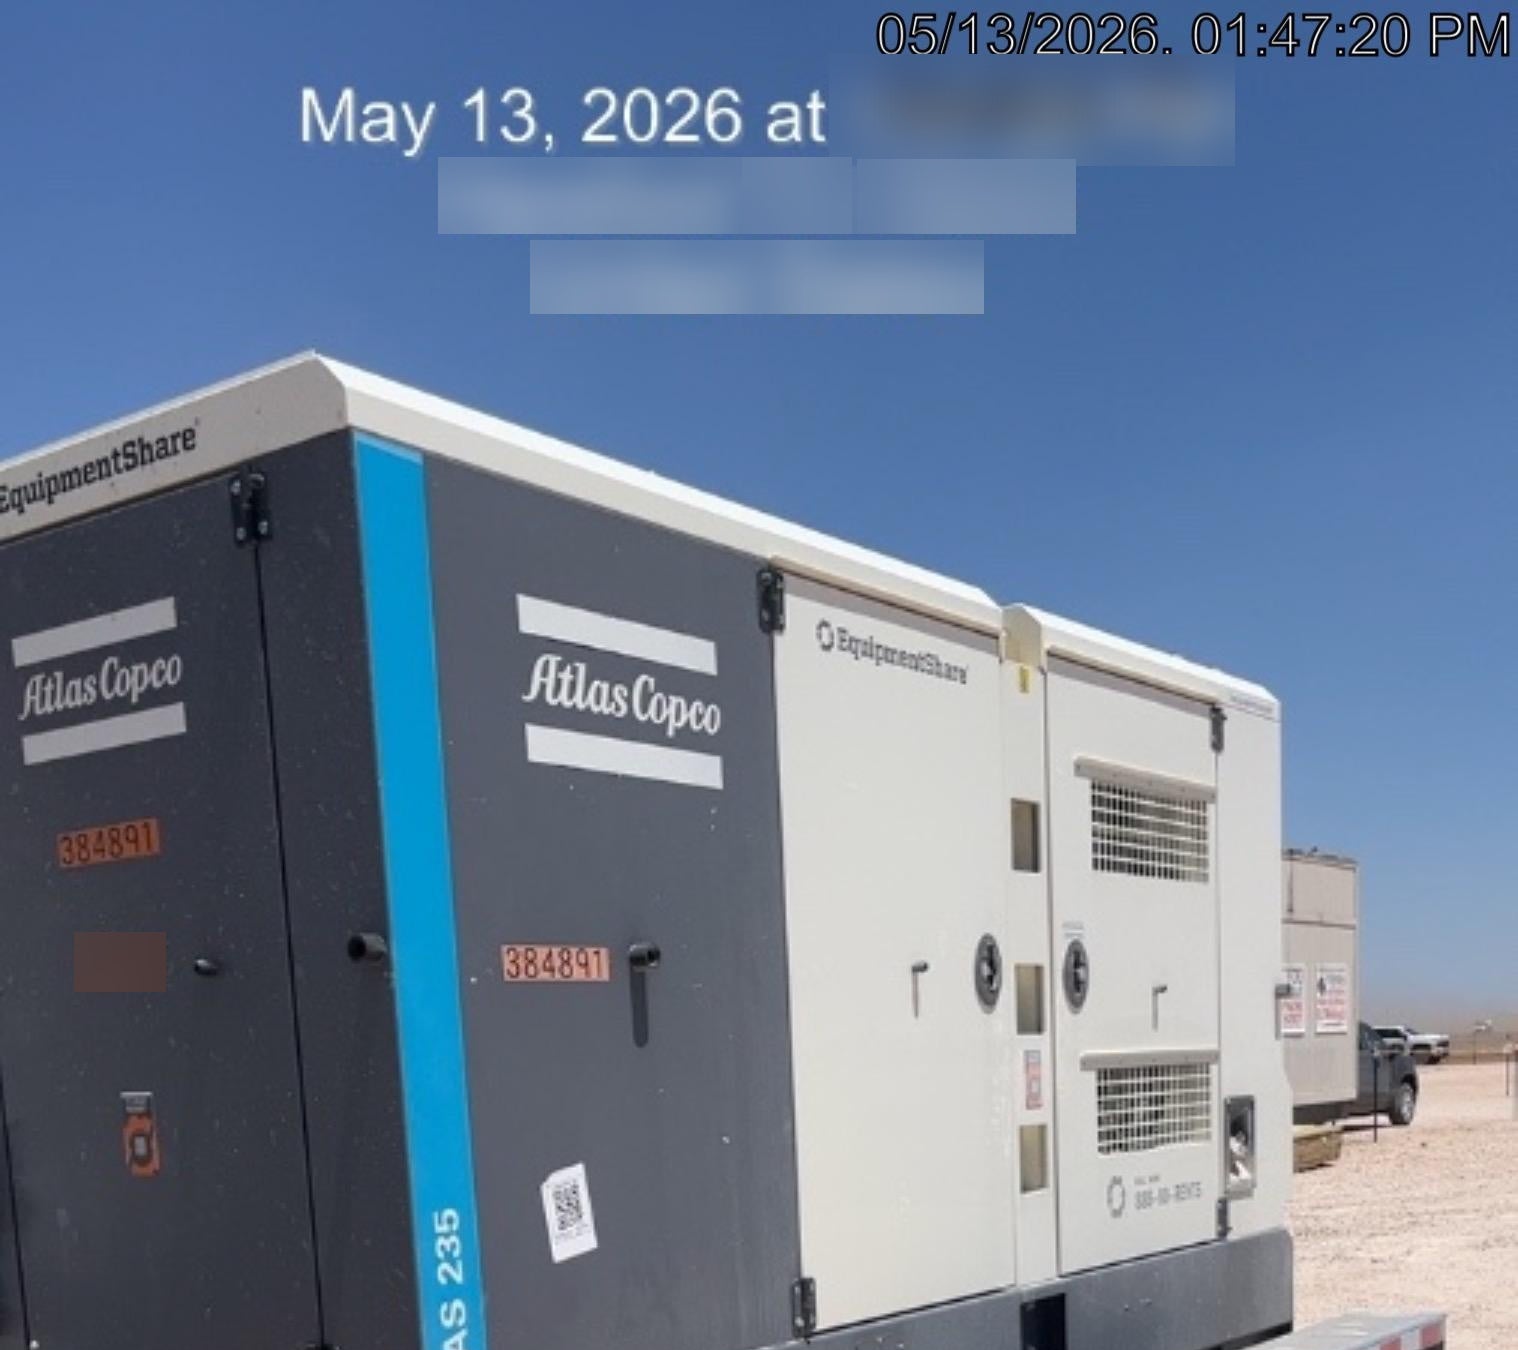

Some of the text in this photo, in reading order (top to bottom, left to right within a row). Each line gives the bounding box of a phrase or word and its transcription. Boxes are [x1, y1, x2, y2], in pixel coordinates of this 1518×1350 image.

[837, 626, 968, 685] EquipmentShare
[60, 821, 153, 866] 384891
[506, 947, 601, 978] 384891
[433, 1208, 464, 1285] 235
